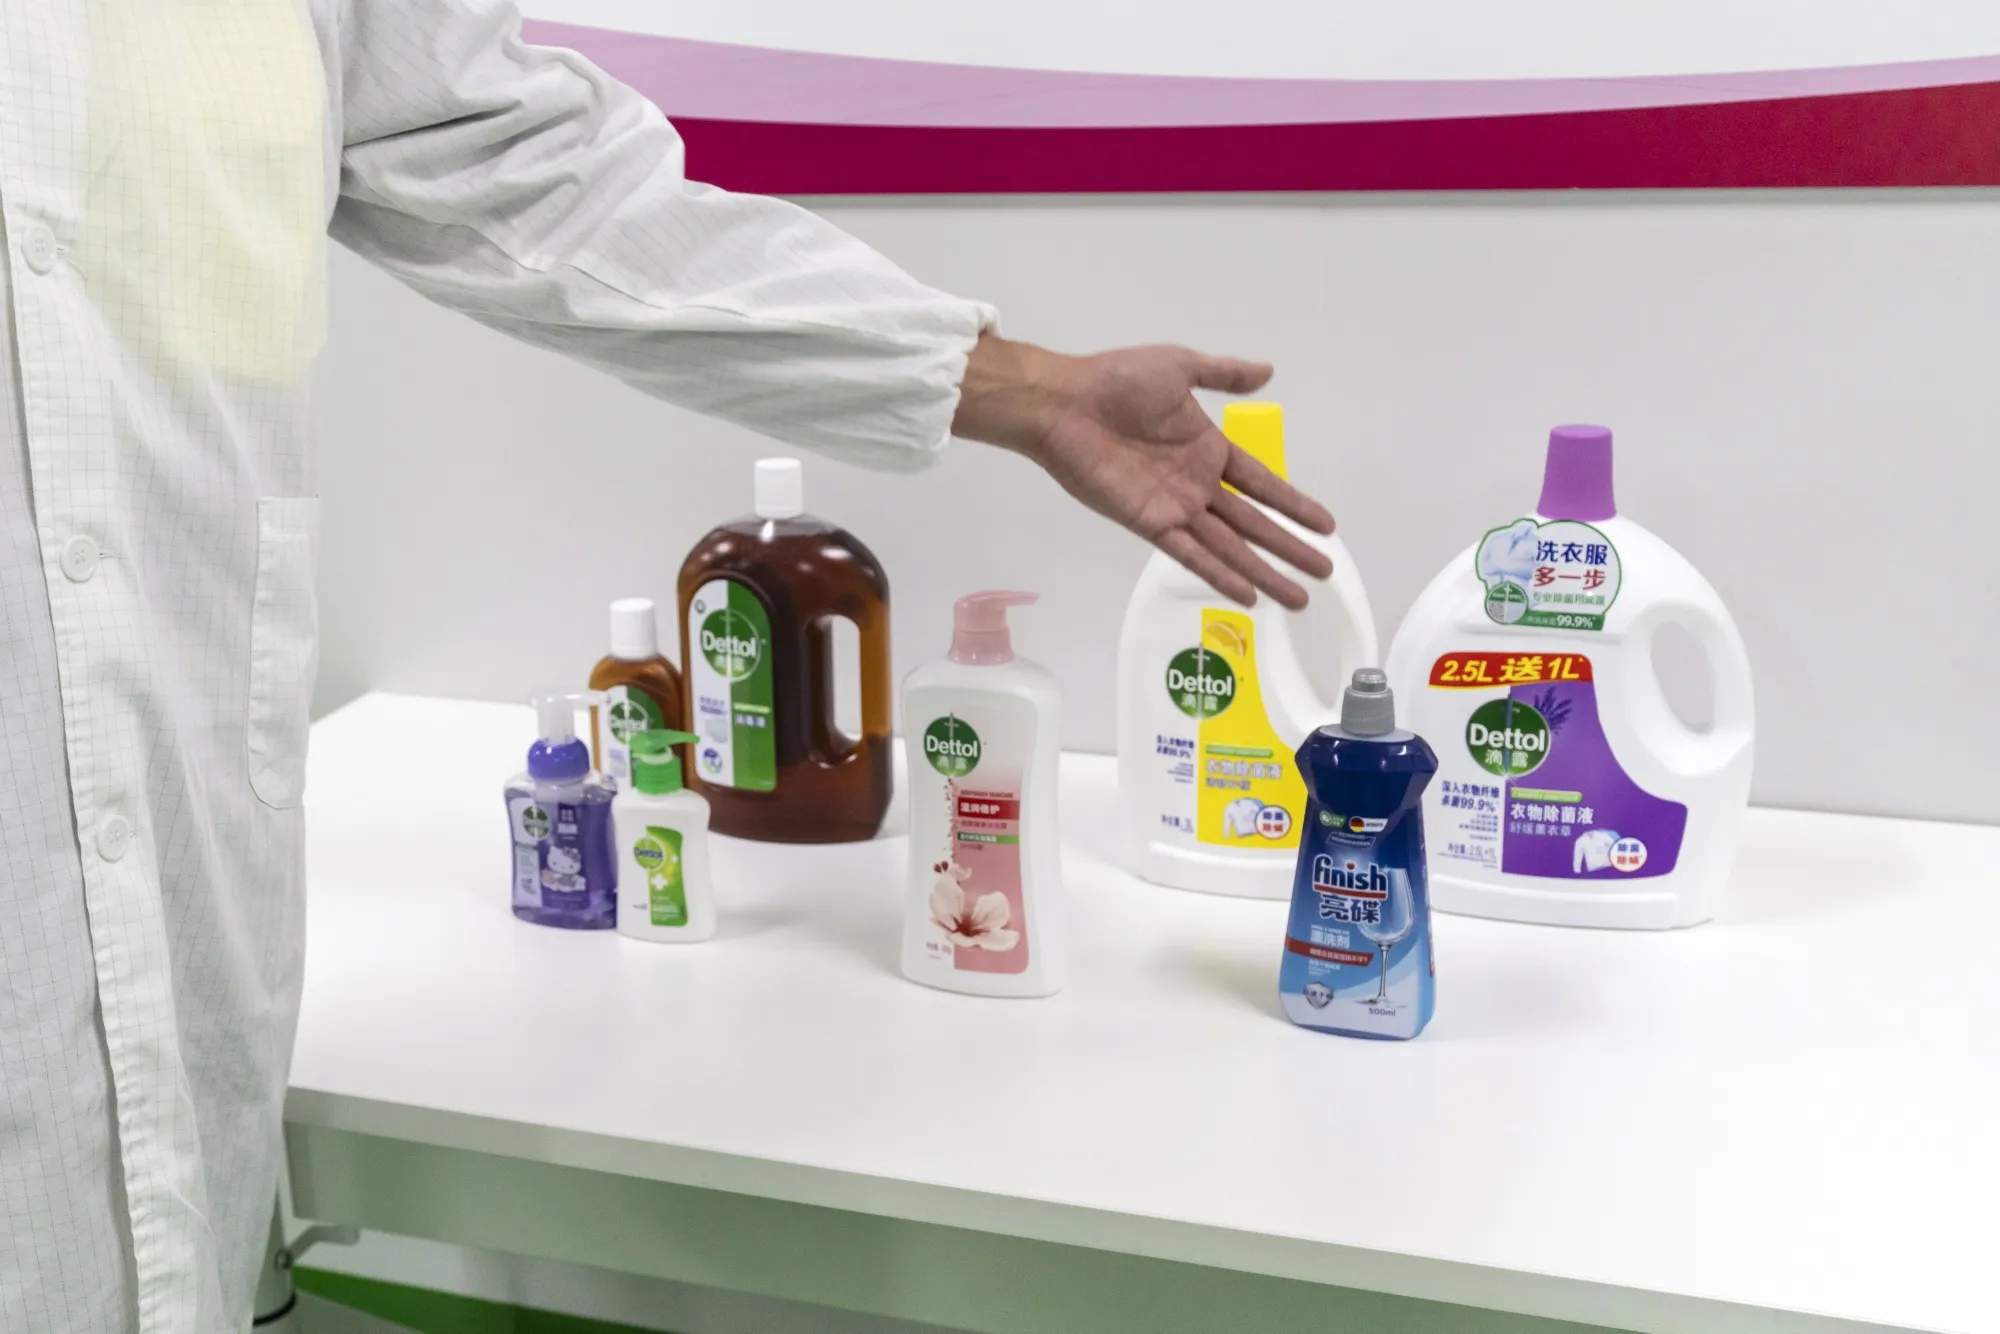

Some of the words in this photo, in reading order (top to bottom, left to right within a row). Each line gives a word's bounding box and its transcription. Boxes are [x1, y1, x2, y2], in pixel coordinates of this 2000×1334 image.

[1536, 540, 1608, 565] 洗衣服
[1533, 566, 1606, 590] 多一步
[702, 630, 756, 658] Dettol
[1440, 660, 1493, 682] 2.5L
[1499, 656, 1543, 682] 送
[1548, 657, 1579, 680] 1L
[1168, 669, 1232, 696] Dettol
[926, 735, 978, 758] Dettol
[1469, 723, 1546, 752] Dettol
[1485, 749, 1528, 768] 滴露
[1510, 803, 1594, 824] 衣物除菌液
[1313, 854, 1388, 892] finish
[1320, 894, 1381, 924] 亮碟
[1368, 1007, 1396, 1017] 500ml
